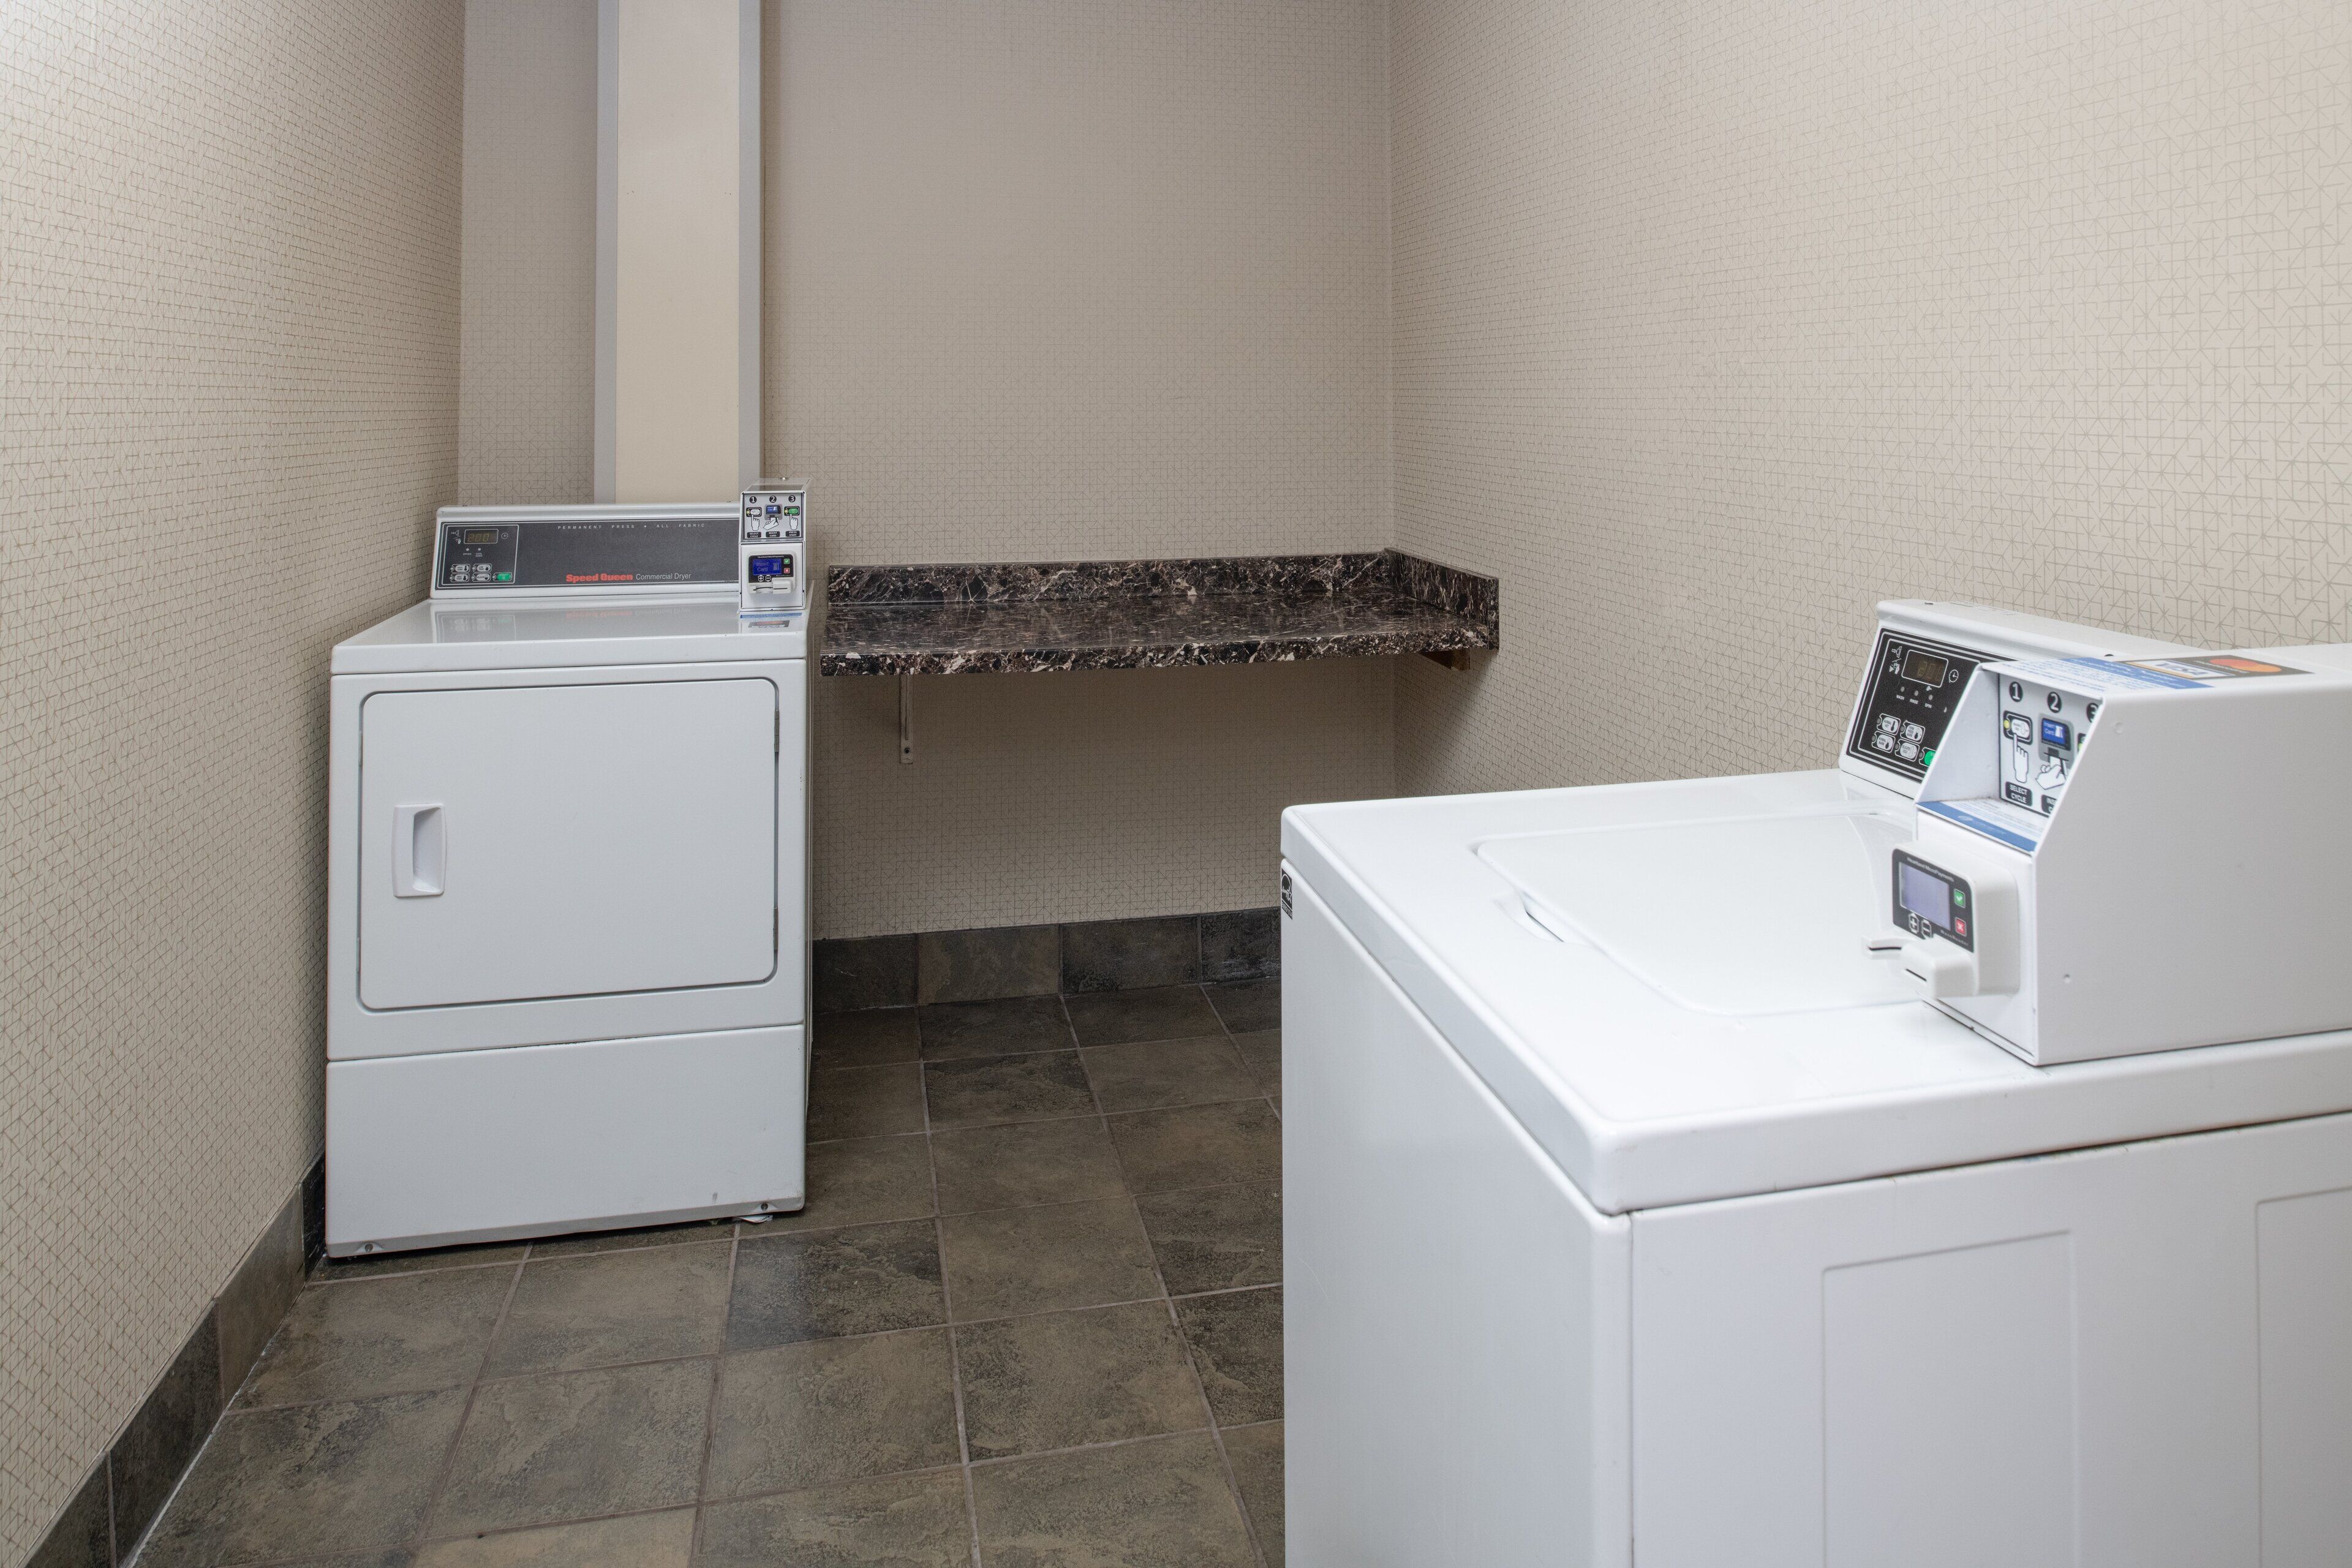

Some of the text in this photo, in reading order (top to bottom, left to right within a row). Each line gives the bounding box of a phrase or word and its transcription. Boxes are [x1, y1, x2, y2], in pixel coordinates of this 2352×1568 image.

[565, 573, 599, 583] Speed
[674, 573, 692, 581] Dryer
[2013, 683, 2020, 701] 1
[2050, 693, 2059, 711] 2
[2010, 784, 2027, 796] SELECT
[2011, 794, 2027, 803] CYCLE
